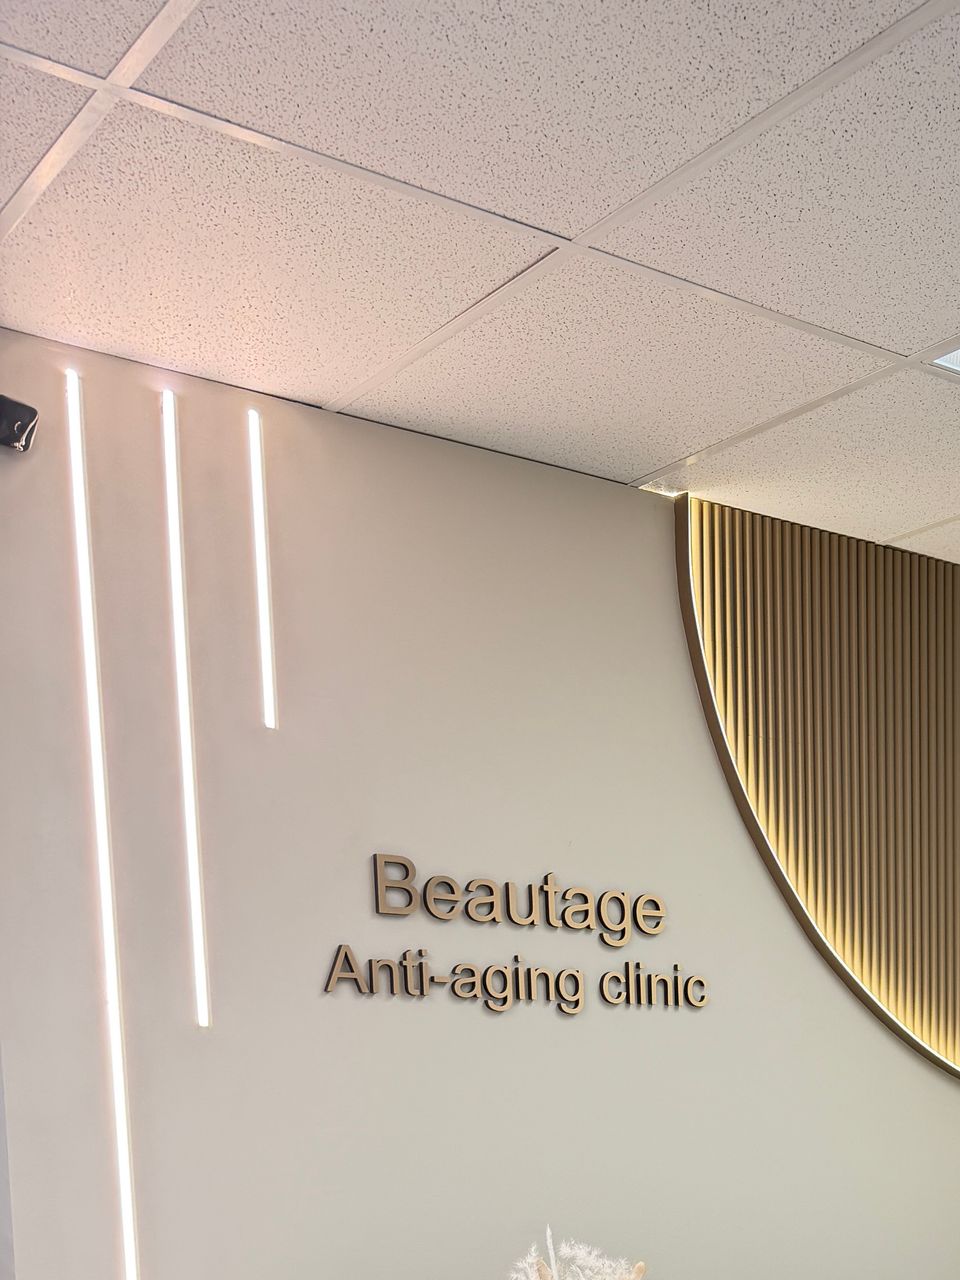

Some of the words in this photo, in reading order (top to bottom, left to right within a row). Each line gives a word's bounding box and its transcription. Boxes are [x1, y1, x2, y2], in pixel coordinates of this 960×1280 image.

[371, 853, 667, 948] Beautage
[324, 944, 585, 1015] Anti-aging
[600, 961, 710, 1008] clinic
